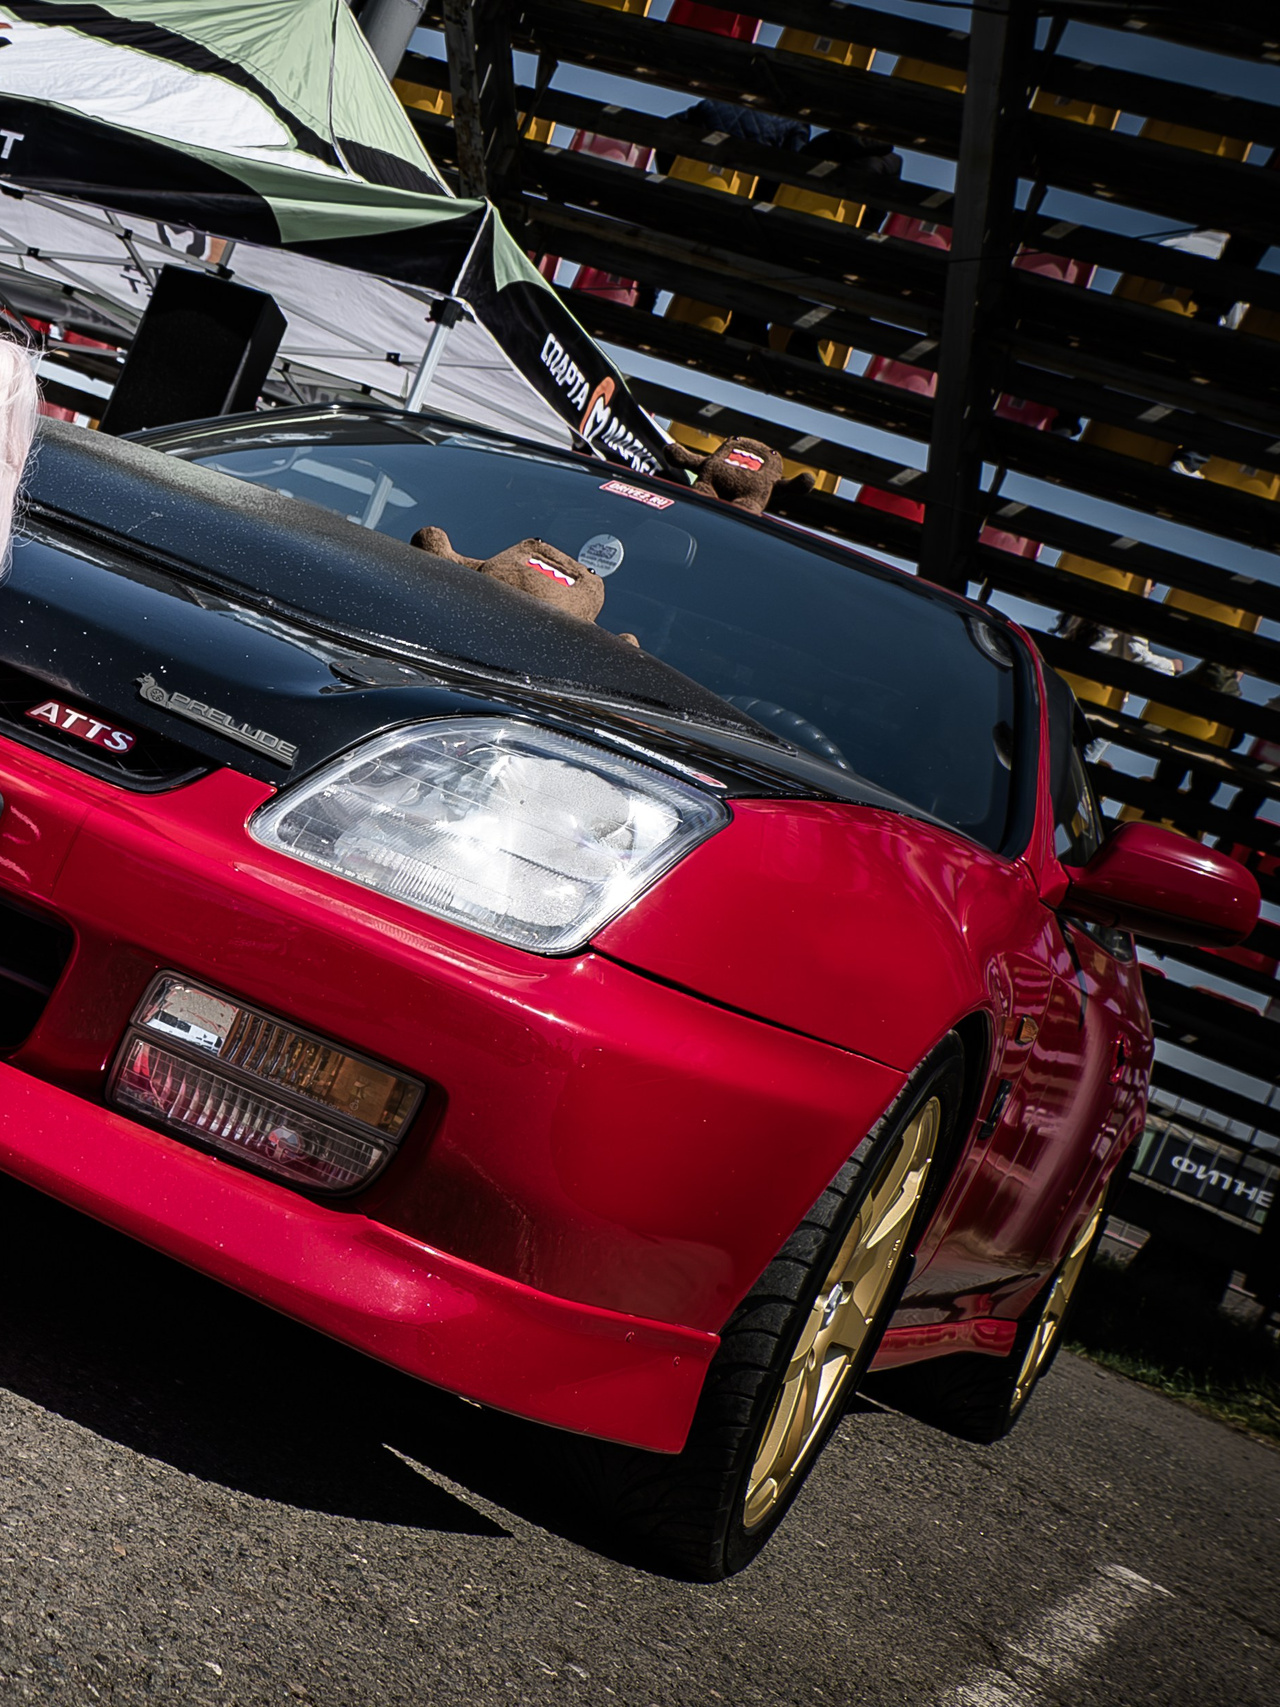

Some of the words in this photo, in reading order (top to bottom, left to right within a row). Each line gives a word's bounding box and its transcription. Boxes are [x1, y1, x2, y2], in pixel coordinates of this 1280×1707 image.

[540, 332, 590, 411] СПАРТА
[29, 701, 134, 751] ATTS
[170, 691, 299, 755] PRELUDE
[1171, 1155, 1275, 1209] ФИТНЕ
